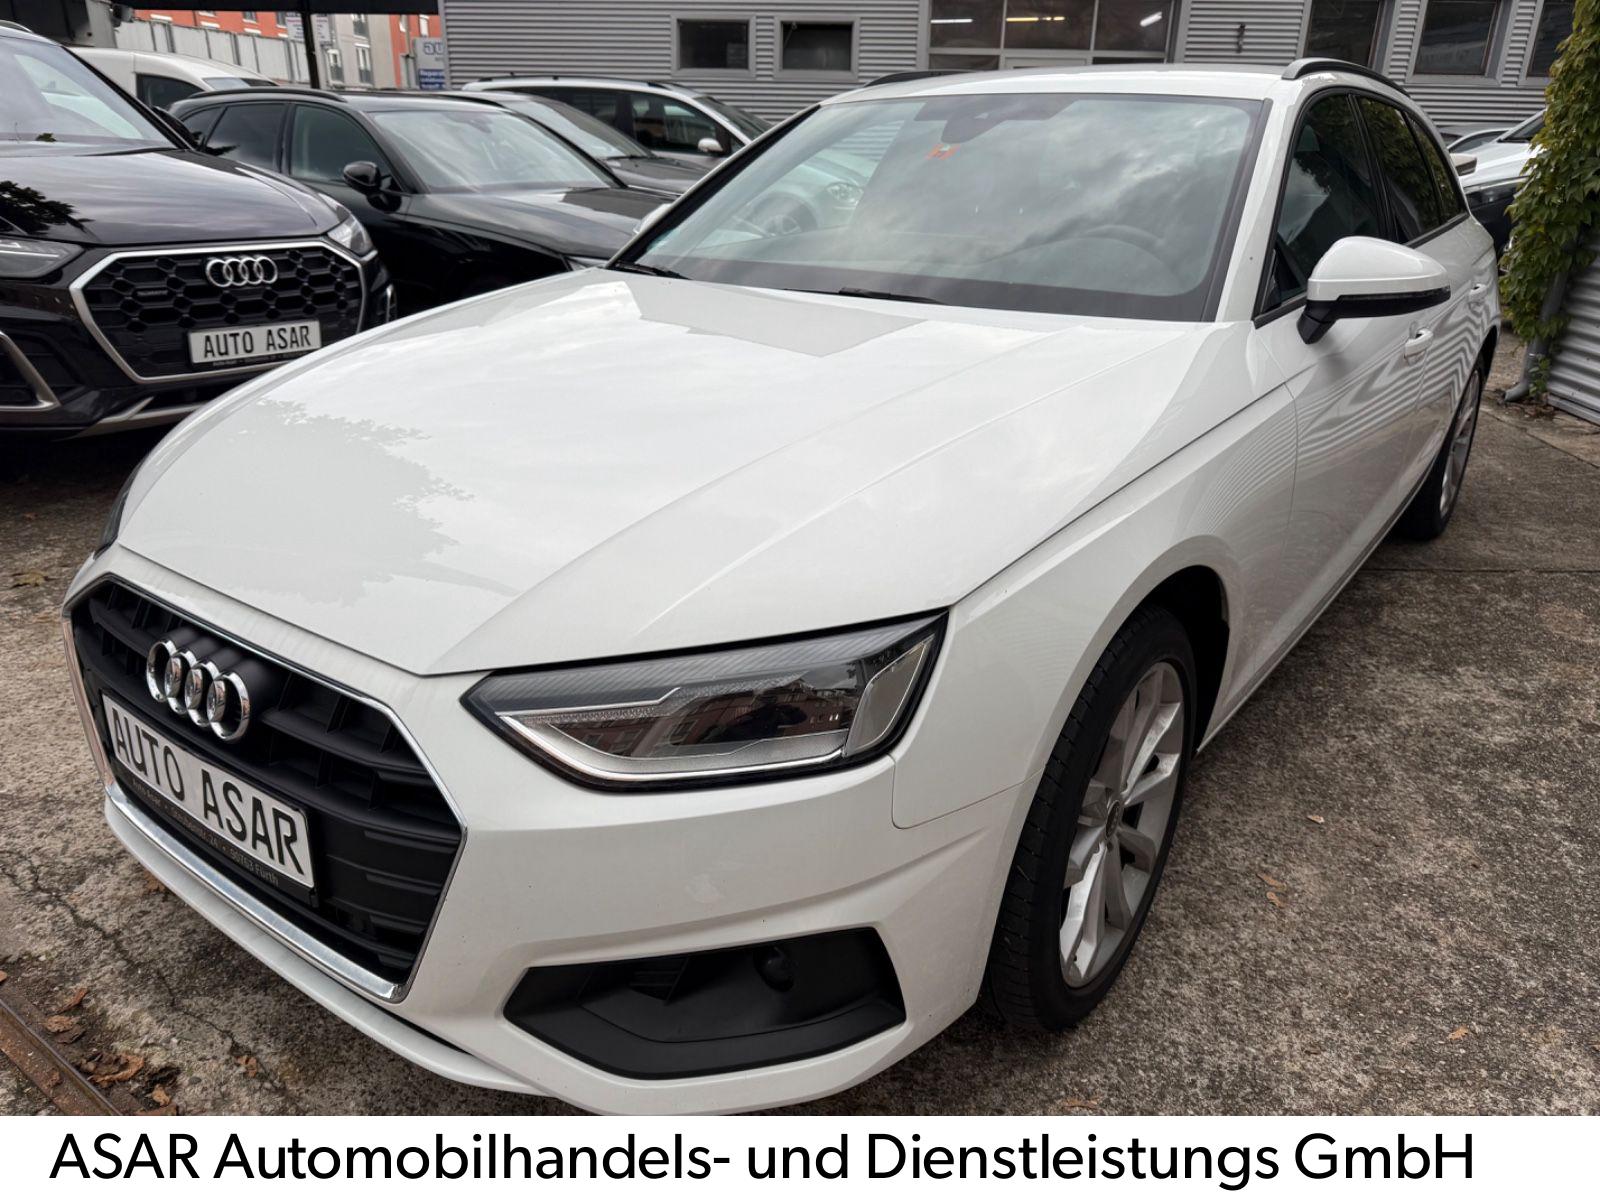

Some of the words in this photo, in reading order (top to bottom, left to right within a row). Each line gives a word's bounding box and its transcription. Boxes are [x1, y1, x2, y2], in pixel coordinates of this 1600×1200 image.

[204, 331, 254, 359] AUTO
[266, 325, 311, 351] ASAR
[111, 706, 186, 802] AUTO
[201, 770, 305, 876] ASAR
